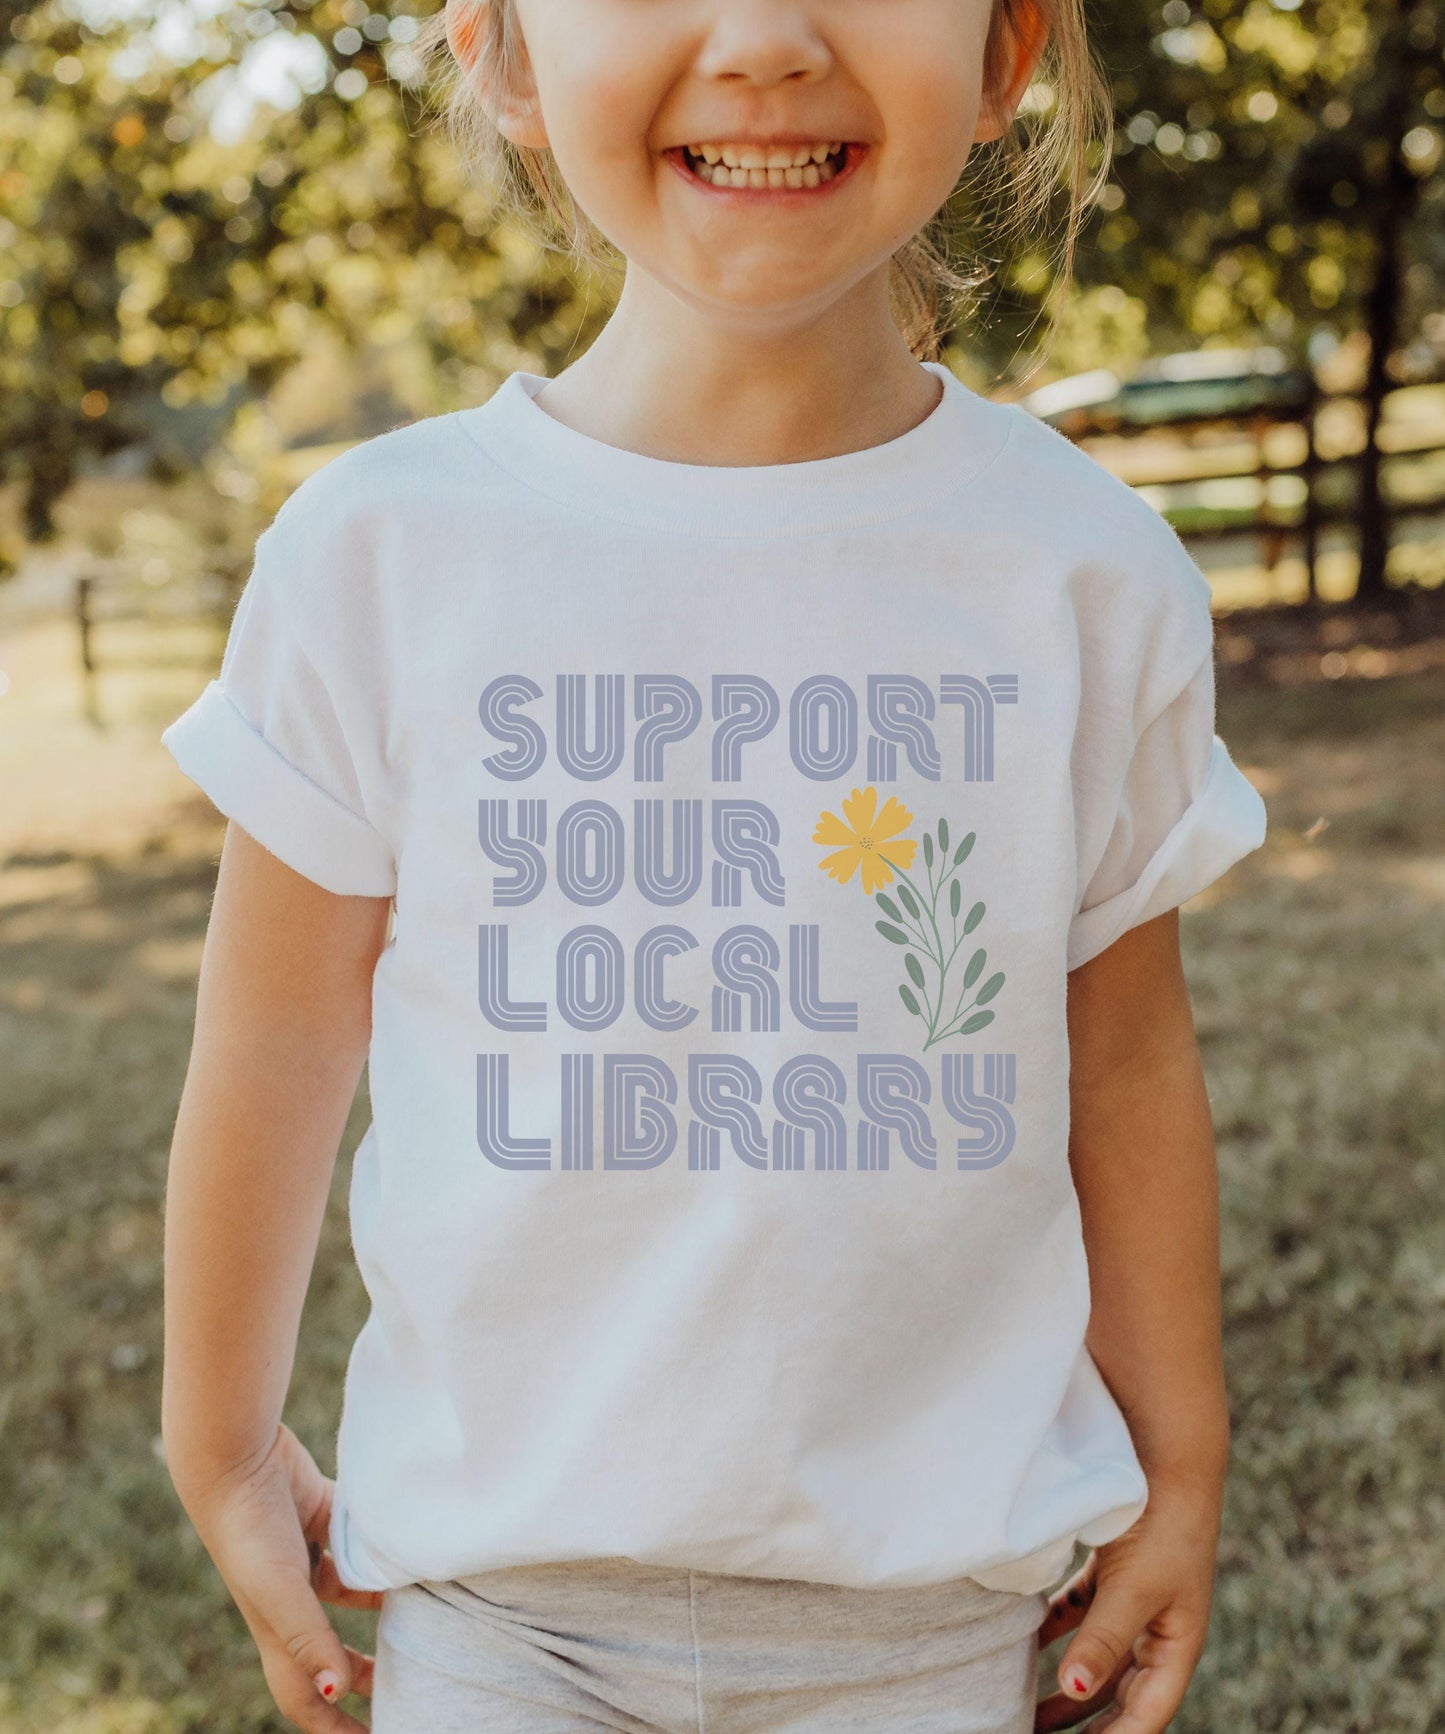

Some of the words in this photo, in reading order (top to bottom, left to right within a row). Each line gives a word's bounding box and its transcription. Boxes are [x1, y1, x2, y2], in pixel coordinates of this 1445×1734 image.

[478, 674, 1019, 782] SUPPORT
[478, 799, 785, 907] YOUR
[478, 924, 858, 1032] LOCAL
[476, 1053, 1017, 1171] LIBRARY
